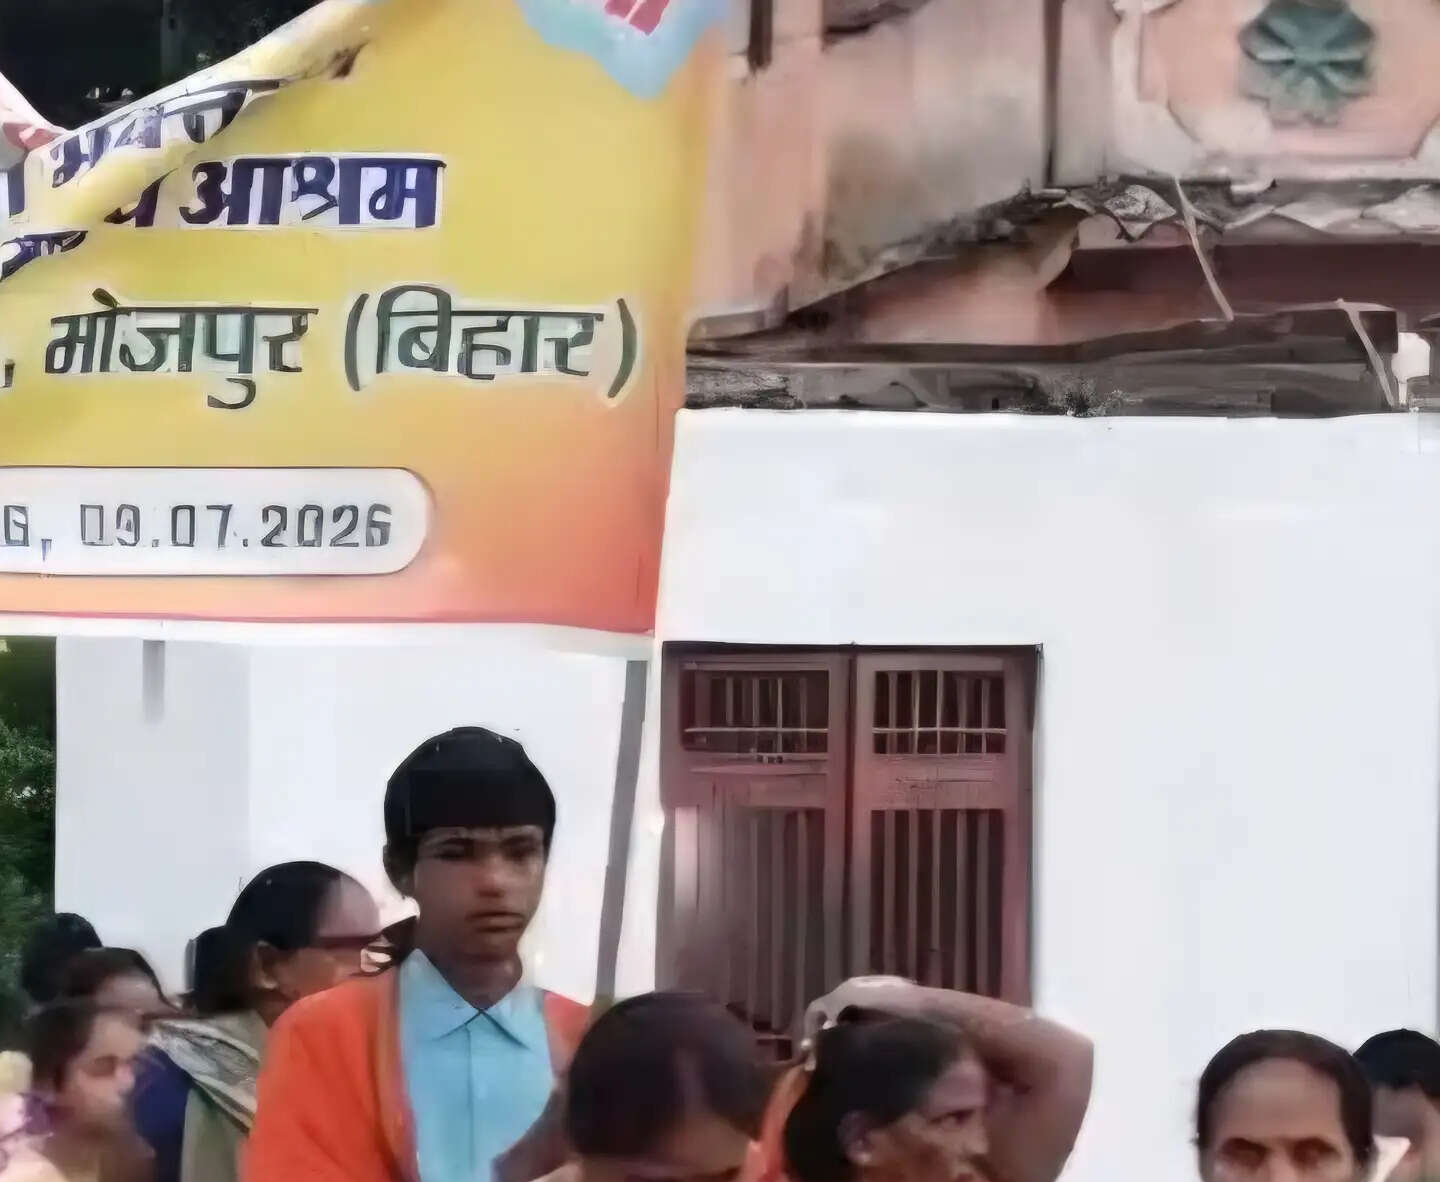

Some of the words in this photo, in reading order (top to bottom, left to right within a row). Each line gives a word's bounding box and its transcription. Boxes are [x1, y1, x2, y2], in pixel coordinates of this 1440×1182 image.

[178, 156, 448, 228] आश्रम
[345, 284, 638, 398] (बिहार)
[80, 504, 393, 548] 09.07.2026
